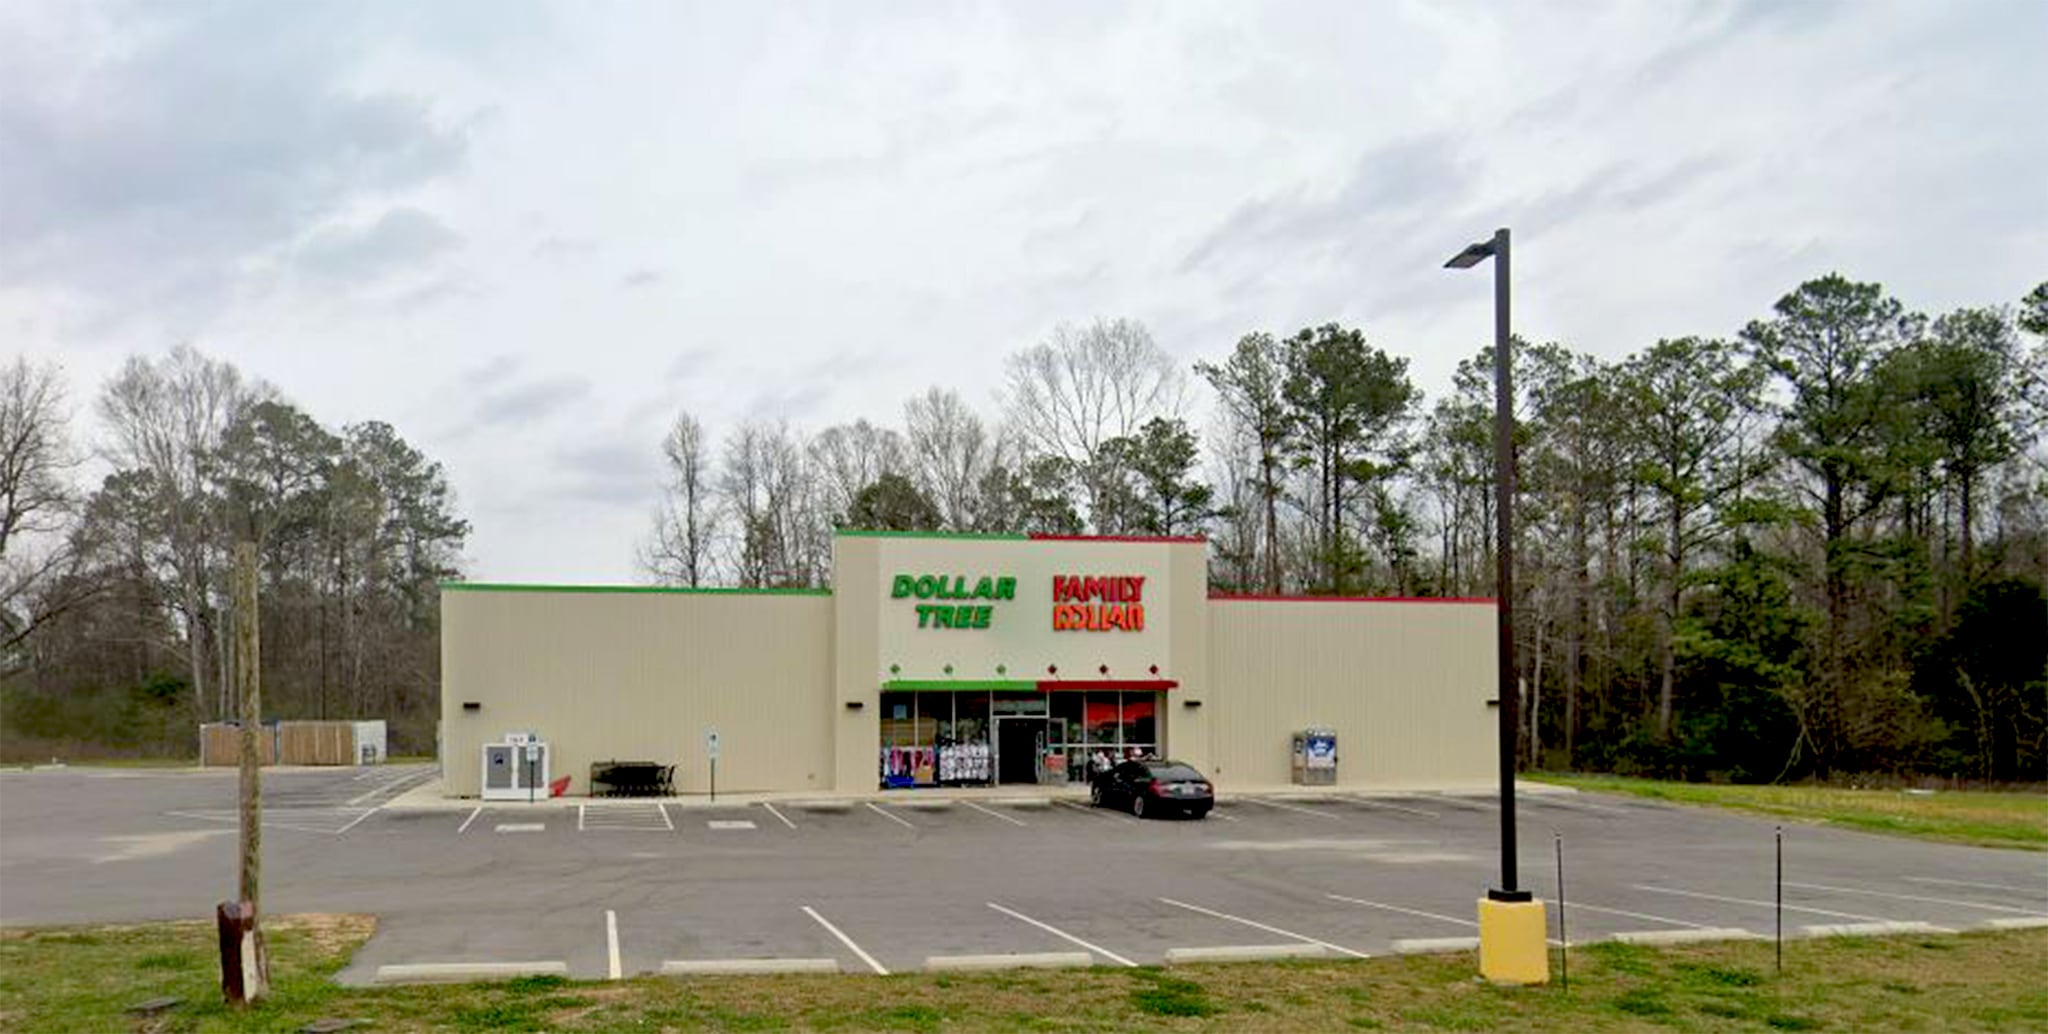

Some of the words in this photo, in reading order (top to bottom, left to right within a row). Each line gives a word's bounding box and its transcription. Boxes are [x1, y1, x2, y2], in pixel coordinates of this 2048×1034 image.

[891, 574, 1017, 600] DOLLAR
[1053, 575, 1145, 602] FAMILY
[914, 604, 993, 630] TREE
[1053, 604, 1144, 632] DOLLAR
